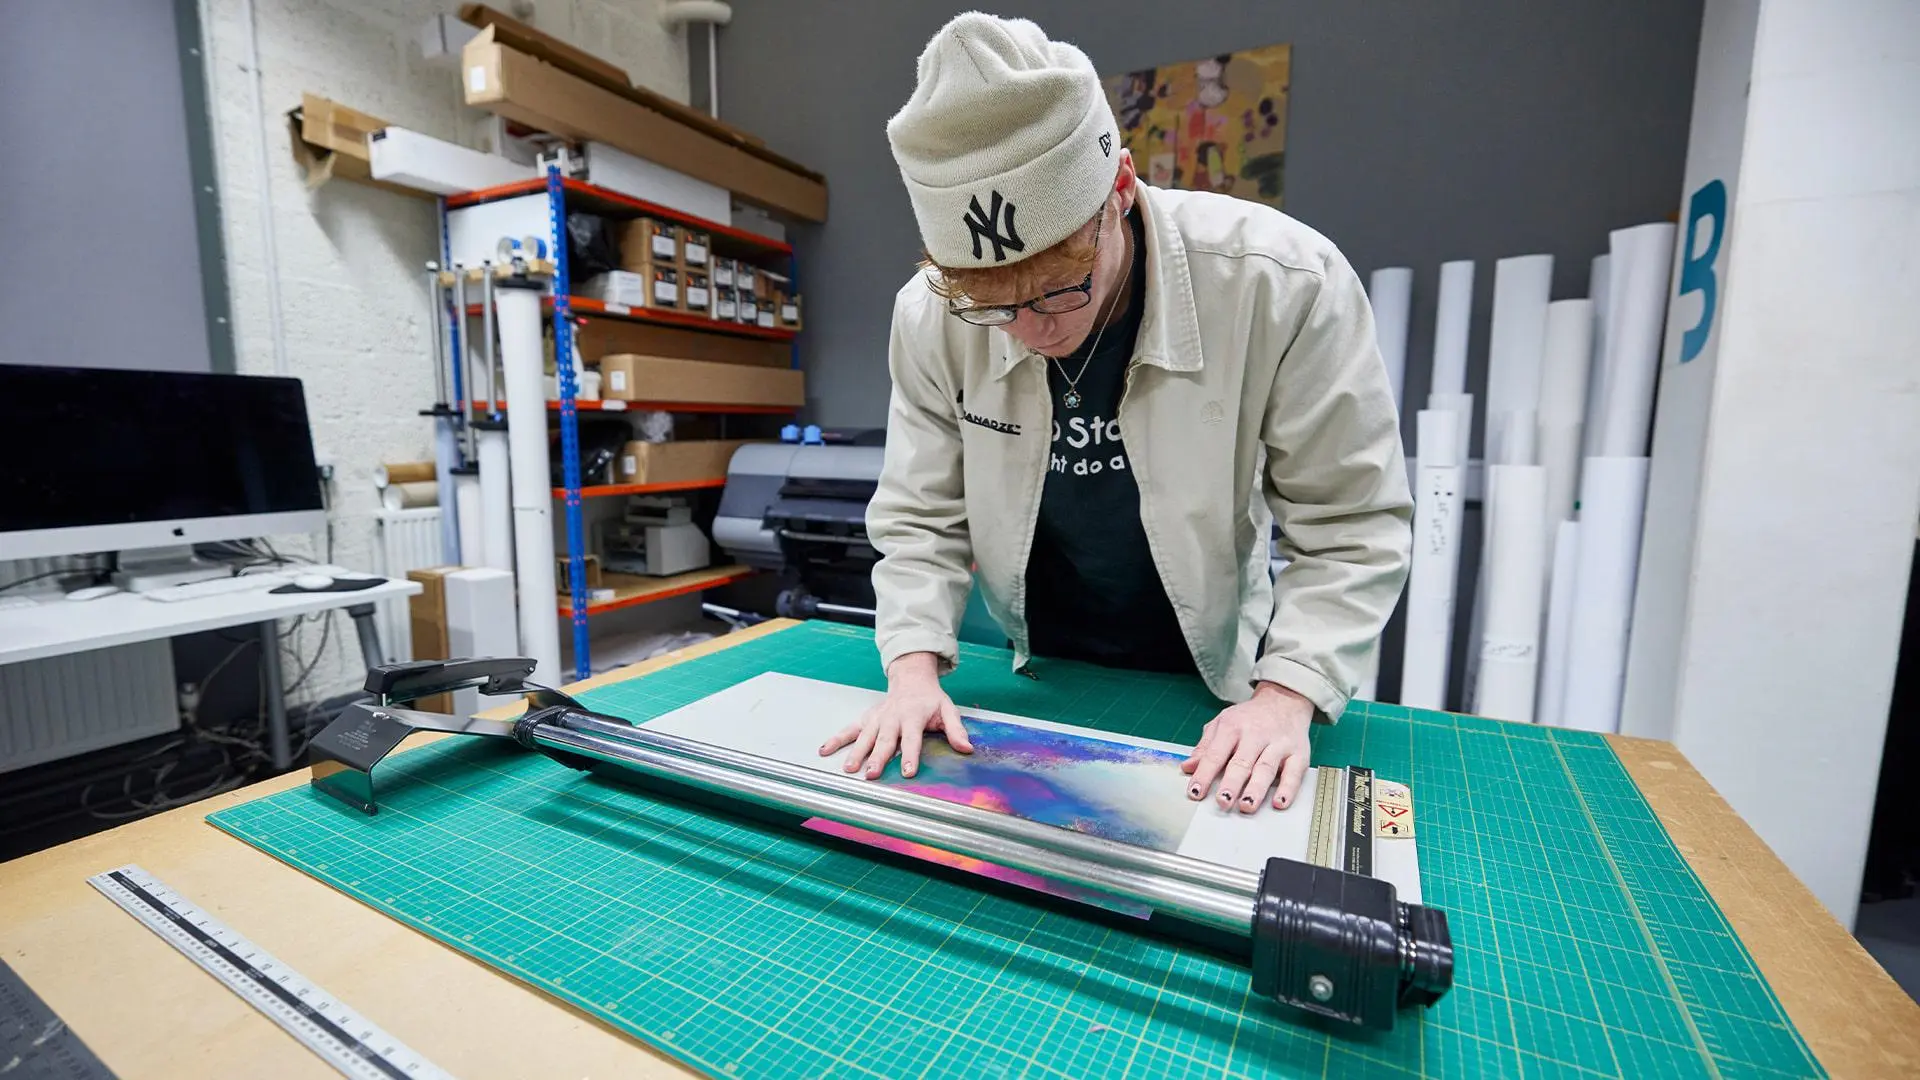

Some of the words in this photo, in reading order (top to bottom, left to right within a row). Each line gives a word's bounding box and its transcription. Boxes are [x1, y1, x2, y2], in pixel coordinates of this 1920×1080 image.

[963, 190, 1025, 262] NY
[1073, 458, 1103, 475] do
[1109, 455, 1126, 470] a
